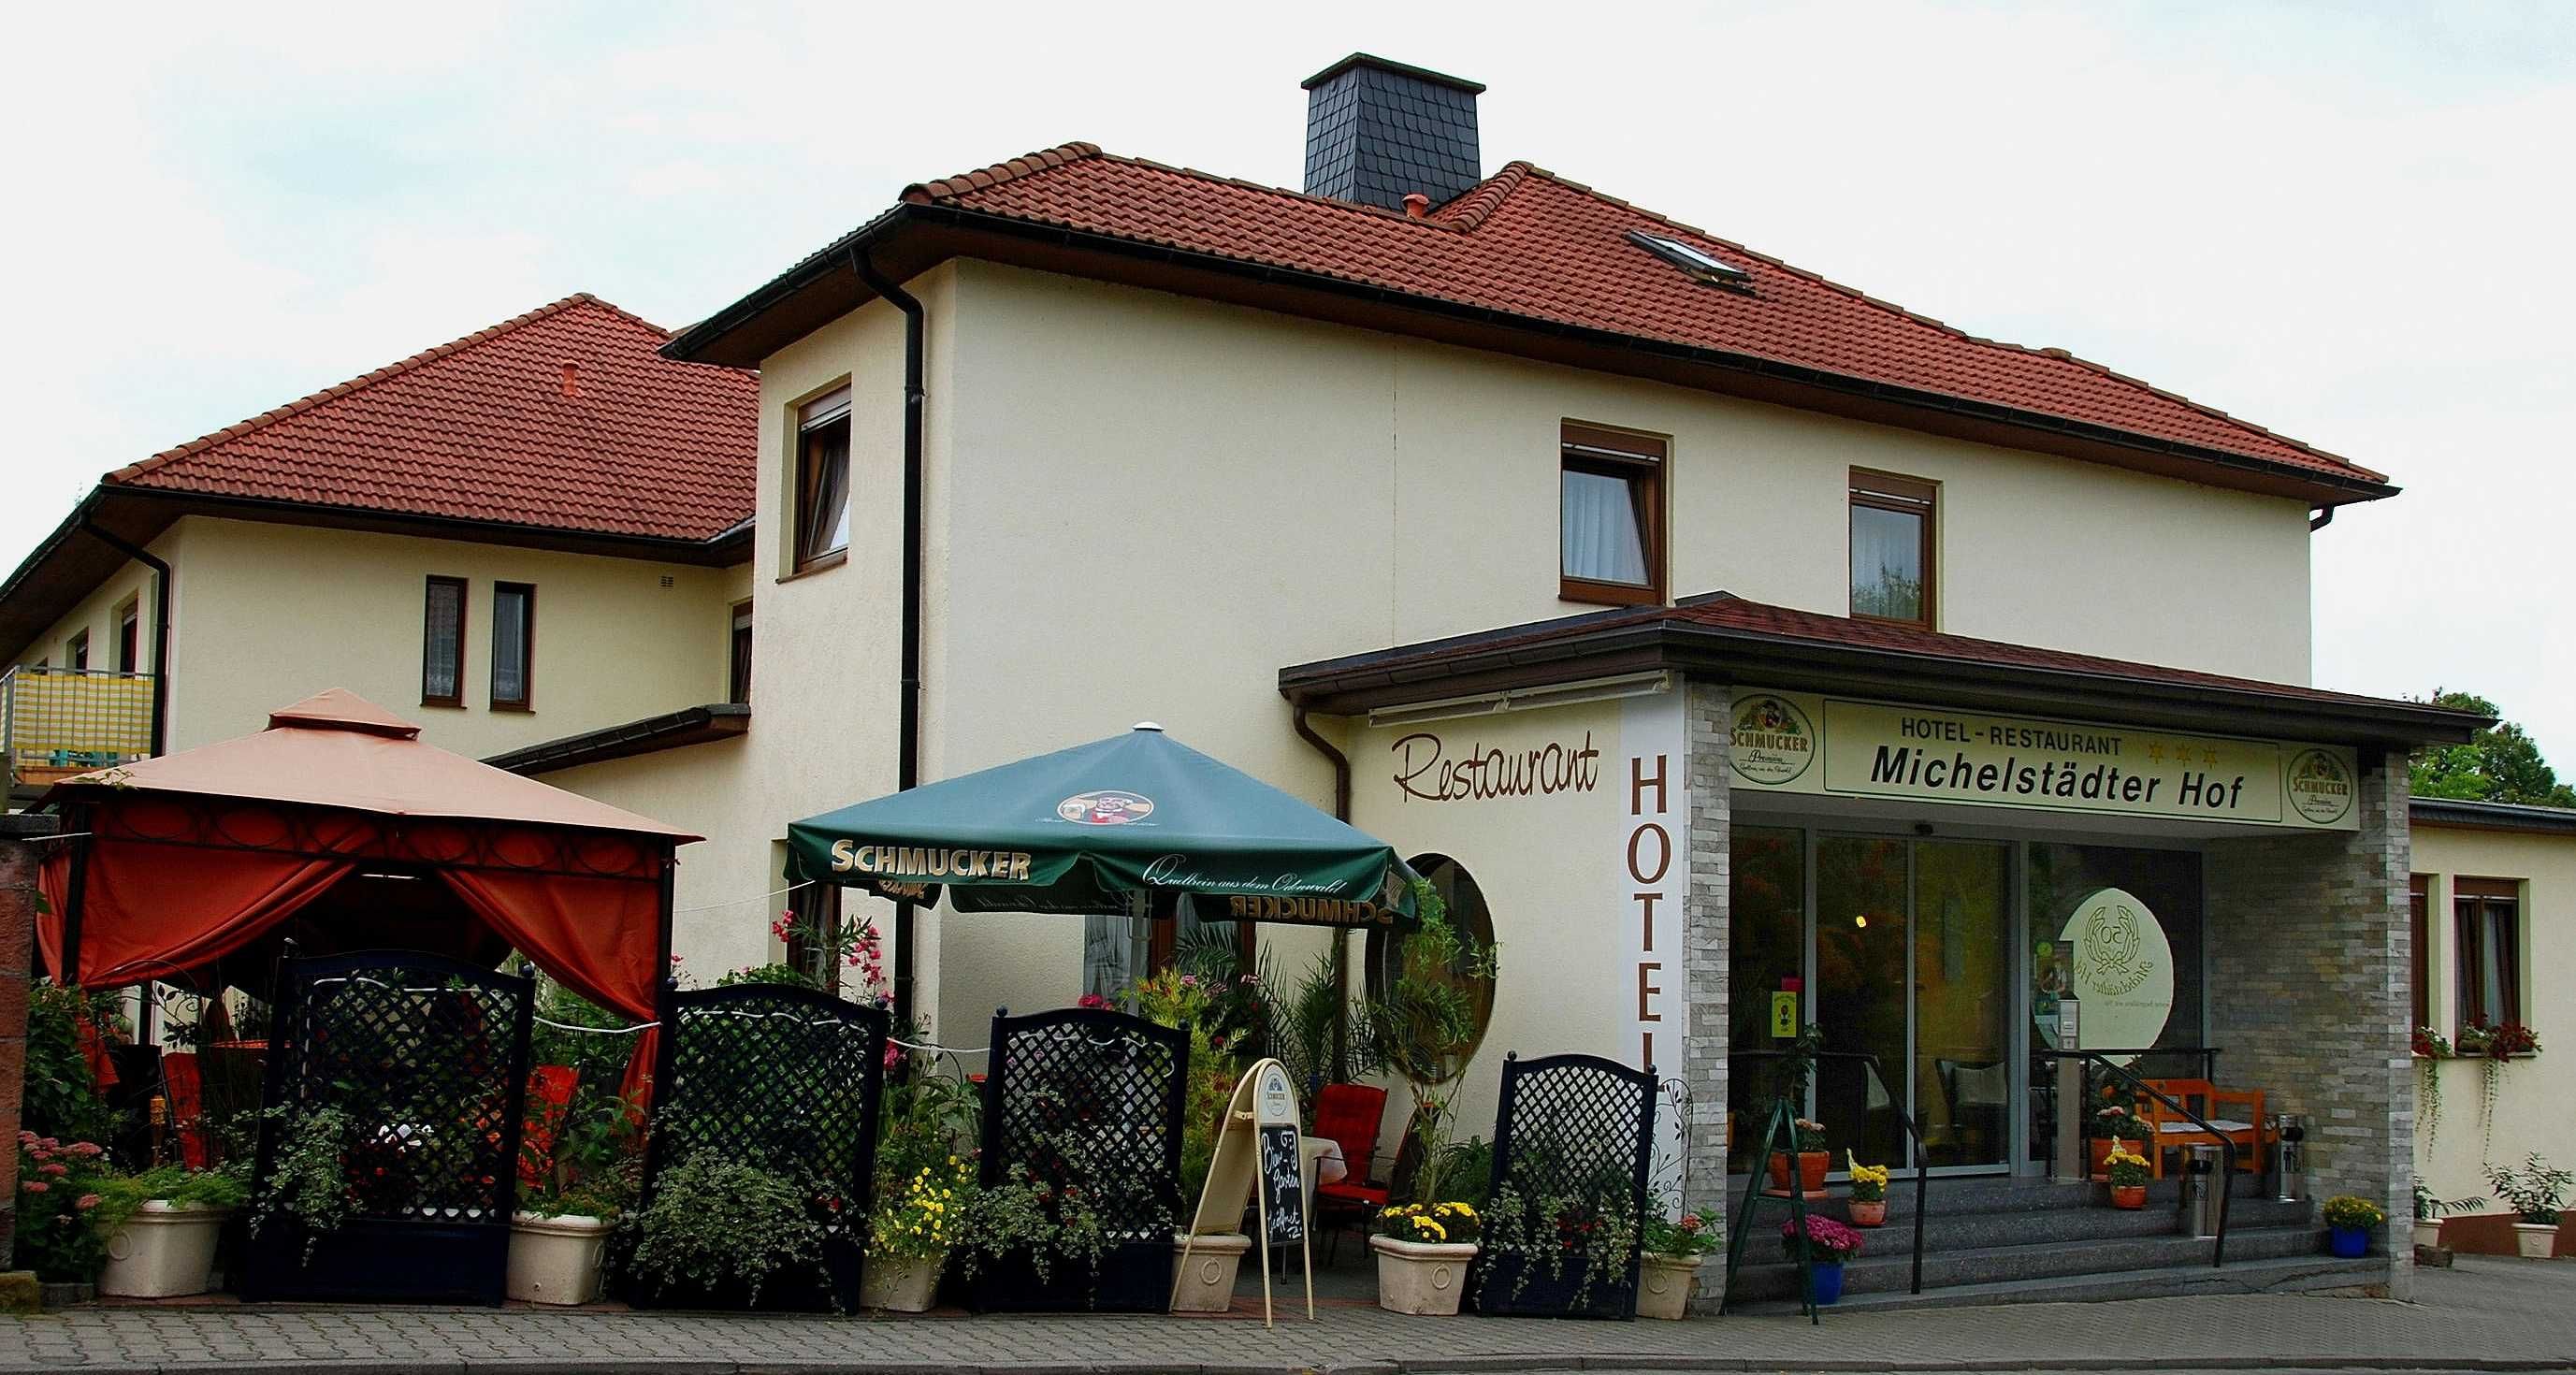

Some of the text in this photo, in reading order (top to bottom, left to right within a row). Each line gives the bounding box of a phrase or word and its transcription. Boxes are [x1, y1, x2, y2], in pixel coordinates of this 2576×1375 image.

[1729, 725, 1808, 753] SCHMUCKER
[1901, 716, 1971, 743] HOTEL
[1990, 726, 2122, 756] RESTAURANT
[1391, 730, 1599, 803] Restaurant
[1871, 745, 2161, 803] Michelstädter
[2178, 772, 2245, 810] Hof
[831, 838, 1032, 881] SCHMUCKER
